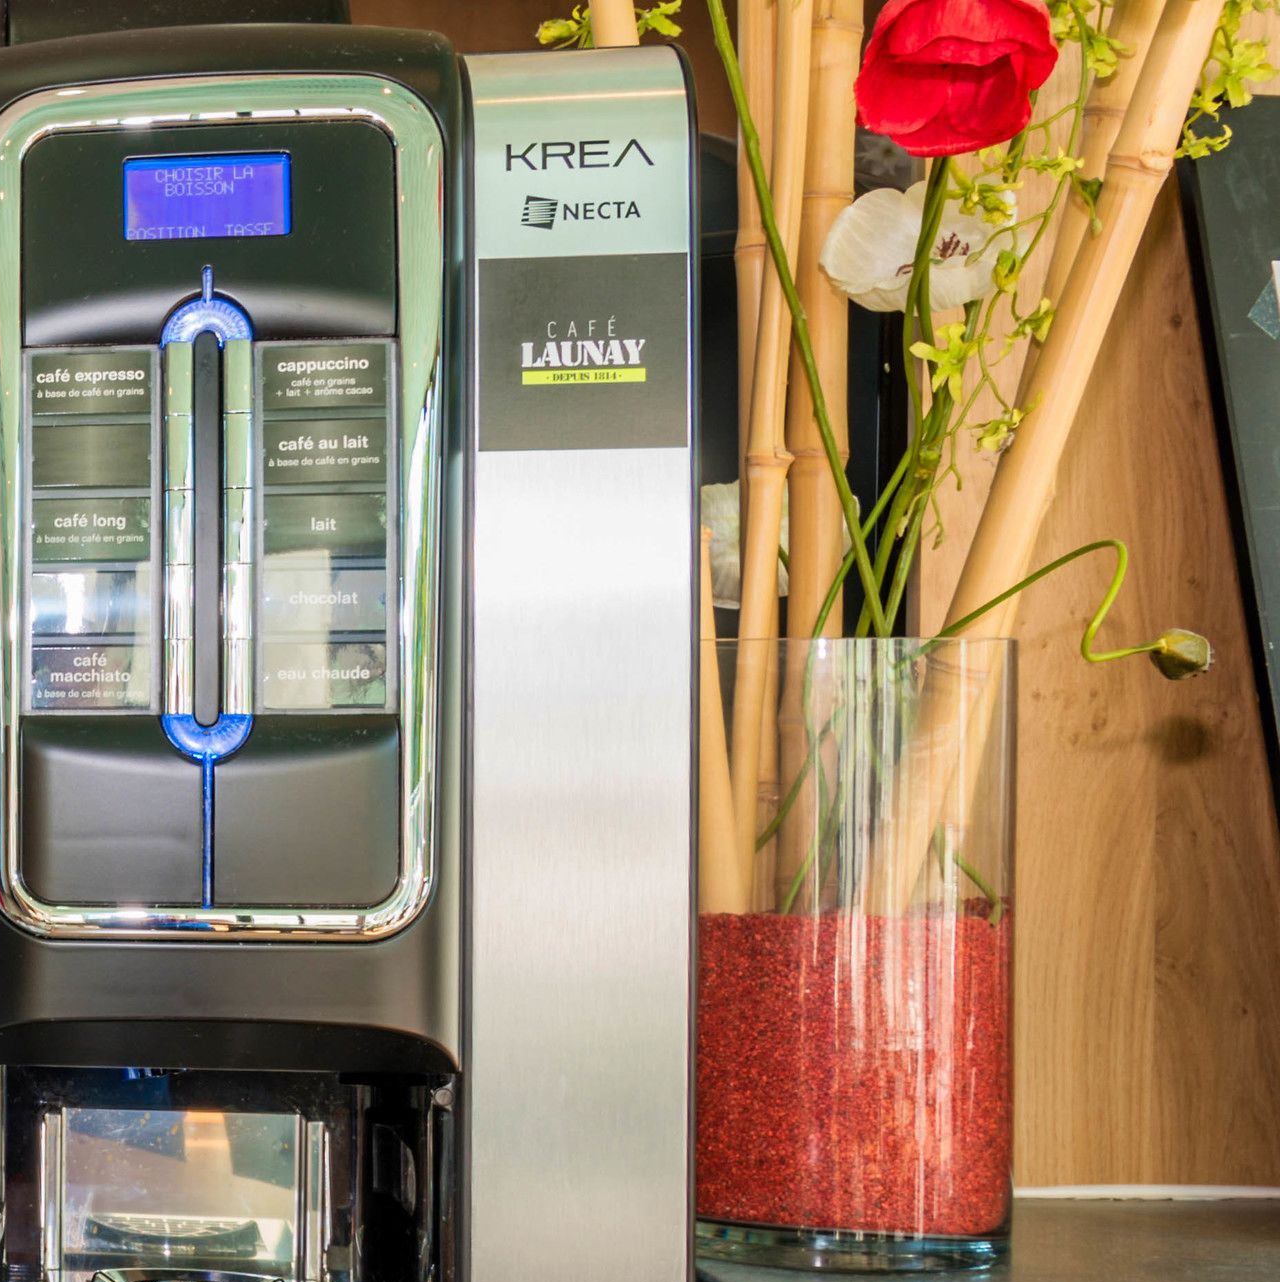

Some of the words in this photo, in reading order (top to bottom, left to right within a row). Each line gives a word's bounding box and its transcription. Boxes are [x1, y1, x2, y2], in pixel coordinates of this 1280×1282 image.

[505, 139, 655, 171] KREA
[155, 167, 224, 183] CHOISIR
[233, 166, 254, 180] LA
[165, 181, 234, 197] BOISSON
[563, 201, 641, 221] NECTA
[127, 226, 206, 240] POSITION
[547, 315, 617, 339] CAFÉ
[521, 339, 646, 368] LAUNAY
[277, 357, 370, 375] cappuccino
[37, 369, 71, 384] café
[75, 370, 145, 385] expresso
[291, 378, 312, 387] café
[327, 378, 356, 388] grains
[552, 372, 590, 382] DEPUIS
[45, 389, 67, 399] base
[69, 389, 80, 398] de
[82, 387, 101, 397] café
[103, 389, 115, 397] en
[117, 387, 145, 398] grains
[286, 388, 301, 397] lait
[345, 387, 374, 395] cacao
[279, 436, 314, 451] café
[319, 438, 338, 450] au
[343, 435, 369, 450] lait
[315, 455, 336, 465] café
[337, 457, 350, 465] en
[351, 456, 380, 466] grains
[54, 513, 89, 529] café
[93, 513, 127, 531] long
[311, 517, 337, 532] lait
[117, 534, 145, 544] grains
[290, 591, 359, 606] chocolat
[73, 653, 108, 667] café
[50, 669, 131, 683] macchiato
[277, 667, 307, 680] eau
[312, 665, 371, 680] chaude
